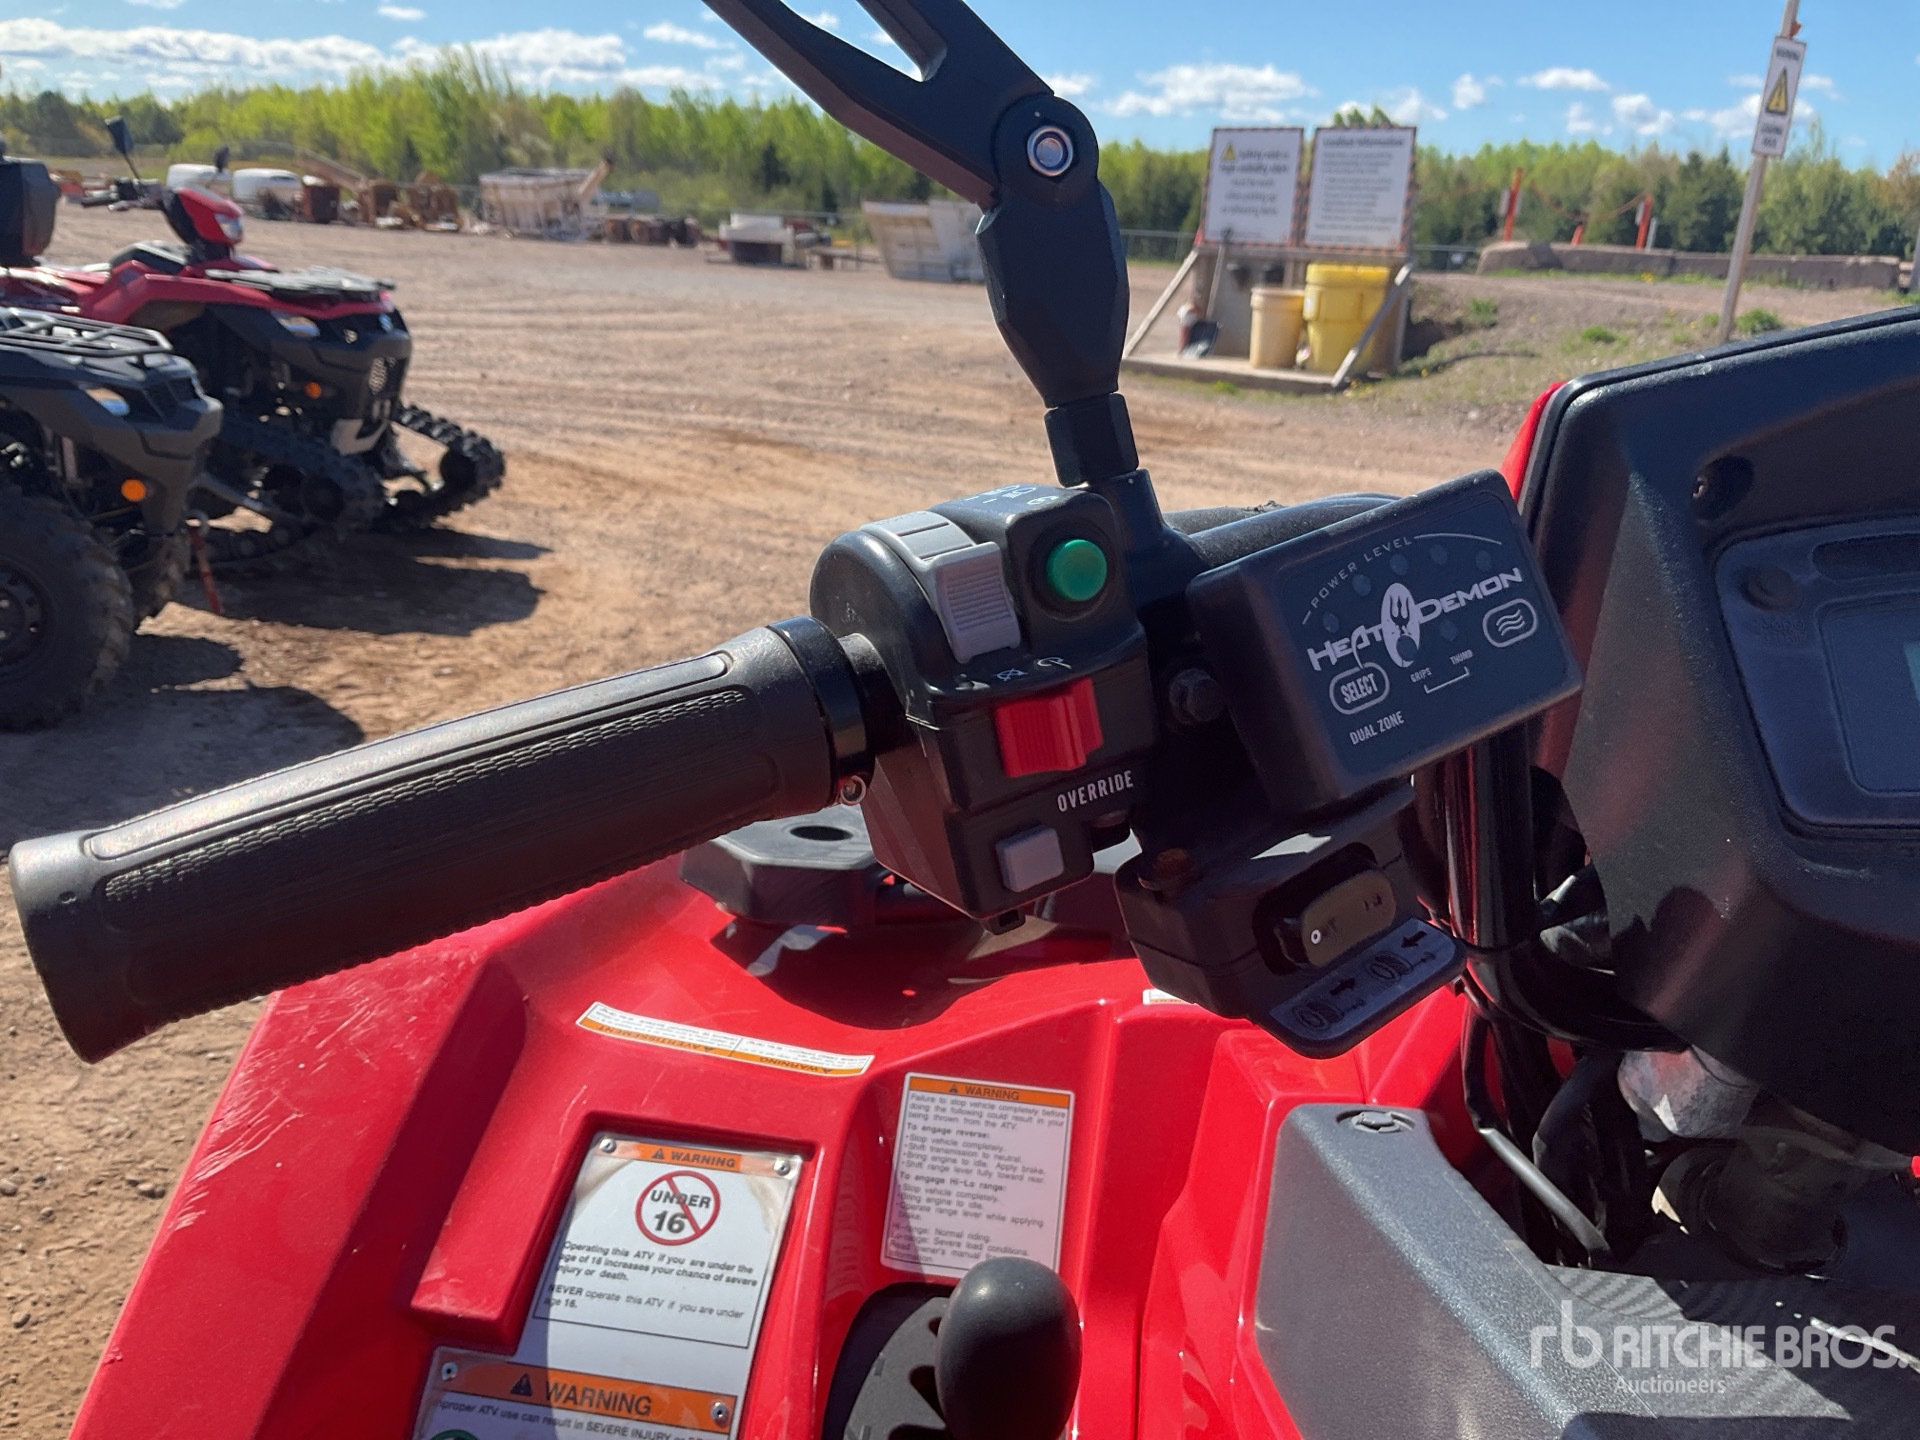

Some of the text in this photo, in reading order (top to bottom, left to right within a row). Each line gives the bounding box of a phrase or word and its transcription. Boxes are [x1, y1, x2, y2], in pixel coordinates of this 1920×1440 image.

[1311, 536, 1412, 608] POWER LEVEL
[1307, 567, 1523, 671] HEAT DEMON
[1450, 649, 1473, 665] THUMB
[1411, 667, 1432, 683] GRIPS
[1340, 672, 1378, 704] SELECT
[1350, 710, 1405, 745] DUAL ZONE
[1057, 771, 1134, 812] OVERRIDE
[758, 1056, 820, 1072] WARNING
[964, 1085, 1020, 1101] WARNING
[909, 1102, 930, 1113] doing
[934, 1104, 947, 1113] the
[950, 1106, 983, 1118] following
[986, 1110, 1008, 1120] could
[1047, 1119, 1065, 1128] your
[950, 1097, 967, 1107] stop
[970, 1099, 995, 1110] vehicle
[998, 1103, 1039, 1116] completely
[1042, 1107, 1066, 1118] before
[908, 1111, 929, 1122] being
[933, 1113, 959, 1123] thrown
[963, 1117, 981, 1126] from
[984, 1119, 997, 1128] the
[907, 1122, 990, 1139] To engage reverse:
[931, 1137, 958, 1147] vehicle
[671, 1150, 735, 1168] WARNING
[927, 1163, 950, 1173] range
[931, 1154, 957, 1165] engine
[996, 1162, 1018, 1173] Apply
[900, 1171, 1007, 1193] To engage Hi-Lo range:
[650, 1189, 712, 1209] UNDER
[653, 1210, 687, 1234] 16
[1009, 1216, 1044, 1228] applying
[934, 1228, 963, 1239] Normal
[565, 1240, 754, 1274] Operating this ATV if you are under the
[579, 1254, 590, 1264] of
[604, 1257, 650, 1272] increases
[651, 1265, 675, 1277] your
[676, 1267, 711, 1281] chance
[713, 1273, 724, 1283] of
[725, 1276, 757, 1287] severe
[584, 1268, 596, 1276] or
[600, 1268, 629, 1281] death.
[548, 1284, 744, 1319] NEVER operate this ATV if you are under
[546, 1381, 652, 1416] WARNING
[478, 1404, 499, 1416] ATV
[501, 1408, 519, 1419] use
[521, 1412, 540, 1422] can
[542, 1414, 572, 1428] result
[574, 1418, 584, 1429] in
[586, 1420, 628, 1437] SEVERE
